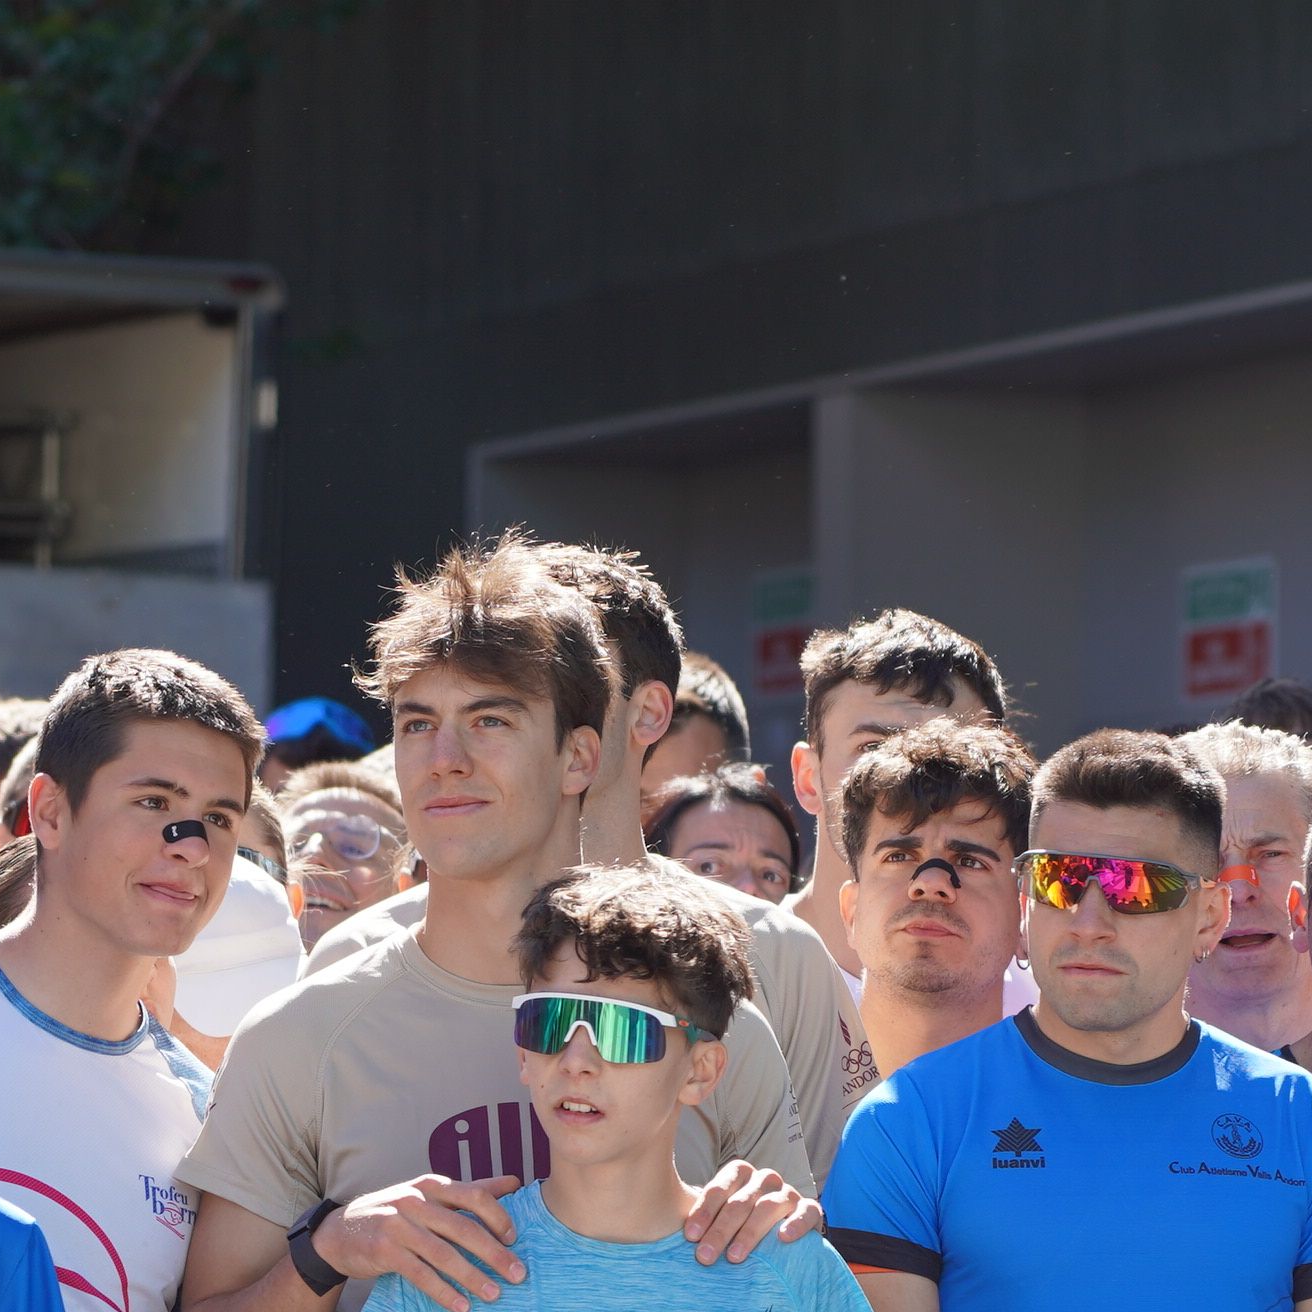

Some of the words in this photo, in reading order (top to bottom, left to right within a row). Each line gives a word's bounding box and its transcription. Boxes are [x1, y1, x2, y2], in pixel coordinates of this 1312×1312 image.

[455, 1100, 536, 1187] ill
[992, 1156, 1046, 1169] luanvi
[1169, 1161, 1196, 1174] Club
